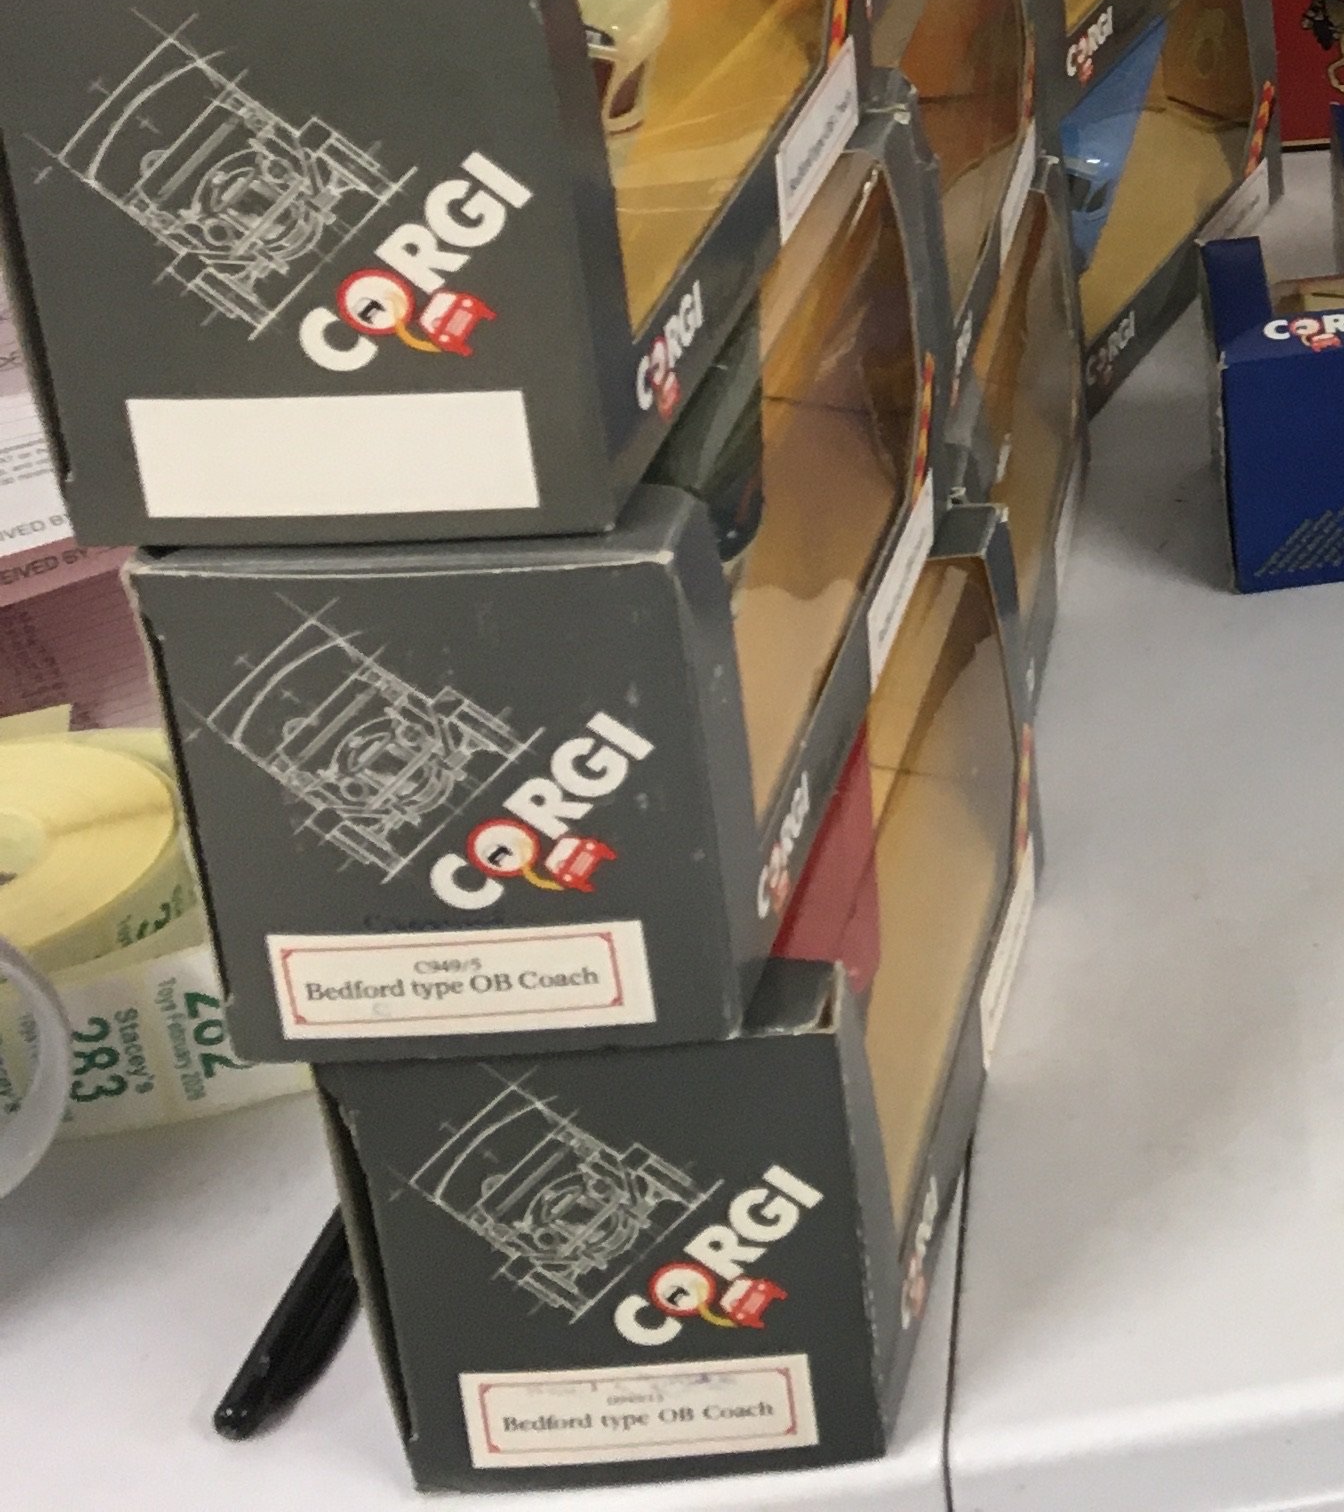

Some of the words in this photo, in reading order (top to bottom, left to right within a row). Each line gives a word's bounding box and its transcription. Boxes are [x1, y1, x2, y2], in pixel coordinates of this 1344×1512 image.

[298, 151, 534, 374] CORGI
[635, 281, 704, 411] CORGI
[0, 554, 58, 587] EIVED
[428, 711, 656, 911] CORGI
[304, 977, 404, 1002] Bedford
[411, 976, 464, 1001] type
[469, 974, 513, 994] OB
[517, 966, 600, 991] Coach
[114, 1007, 155, 1095] Stacey's
[612, 1162, 824, 1347] CORGI
[502, 1413, 593, 1433] Bedford
[600, 1413, 650, 1433] type
[658, 1407, 694, 1424] OB
[702, 1400, 775, 1422] Coach
